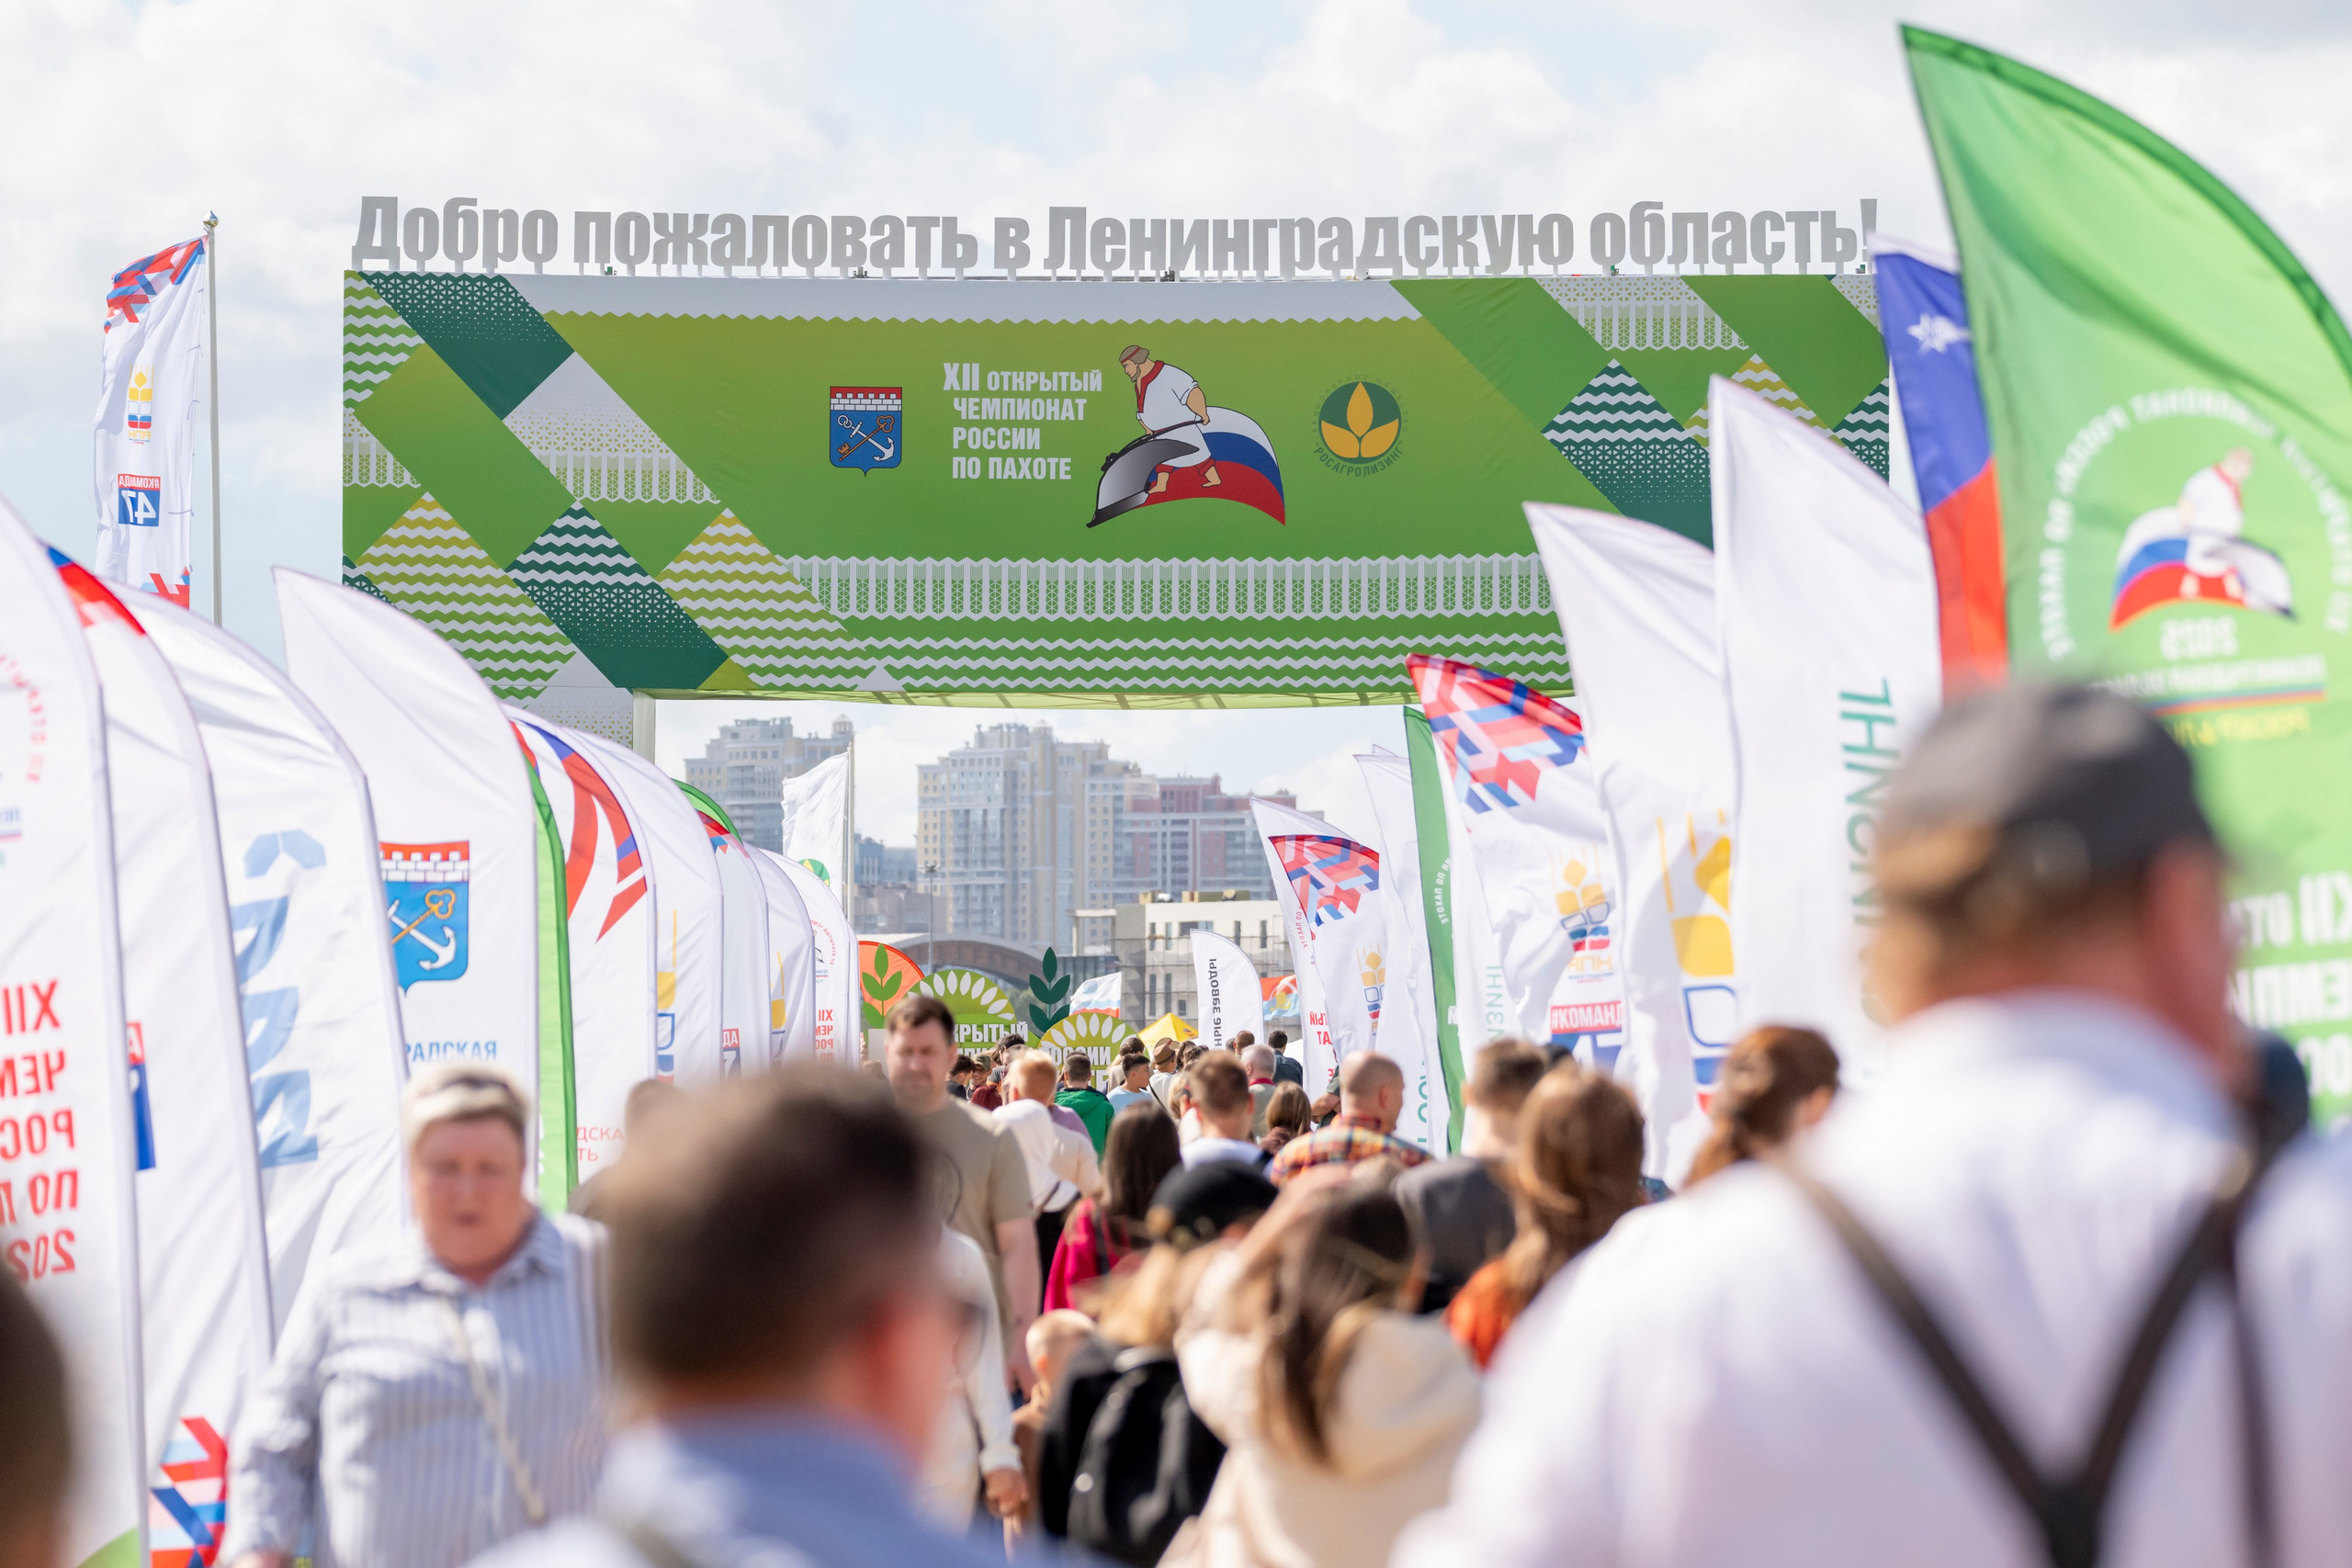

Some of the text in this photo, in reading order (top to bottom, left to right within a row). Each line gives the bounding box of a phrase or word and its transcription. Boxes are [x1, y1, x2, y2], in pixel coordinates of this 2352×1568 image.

[352, 196, 1877, 276] Добро пожаловать в Ленинградскую область!
[987, 368, 1102, 391] ОТКРЫТЫЙ
[953, 397, 1088, 421] ЧЕМПИОНАТ
[952, 426, 1041, 449] РОССИИ
[952, 457, 1072, 479] ПО ПАХОТЕ
